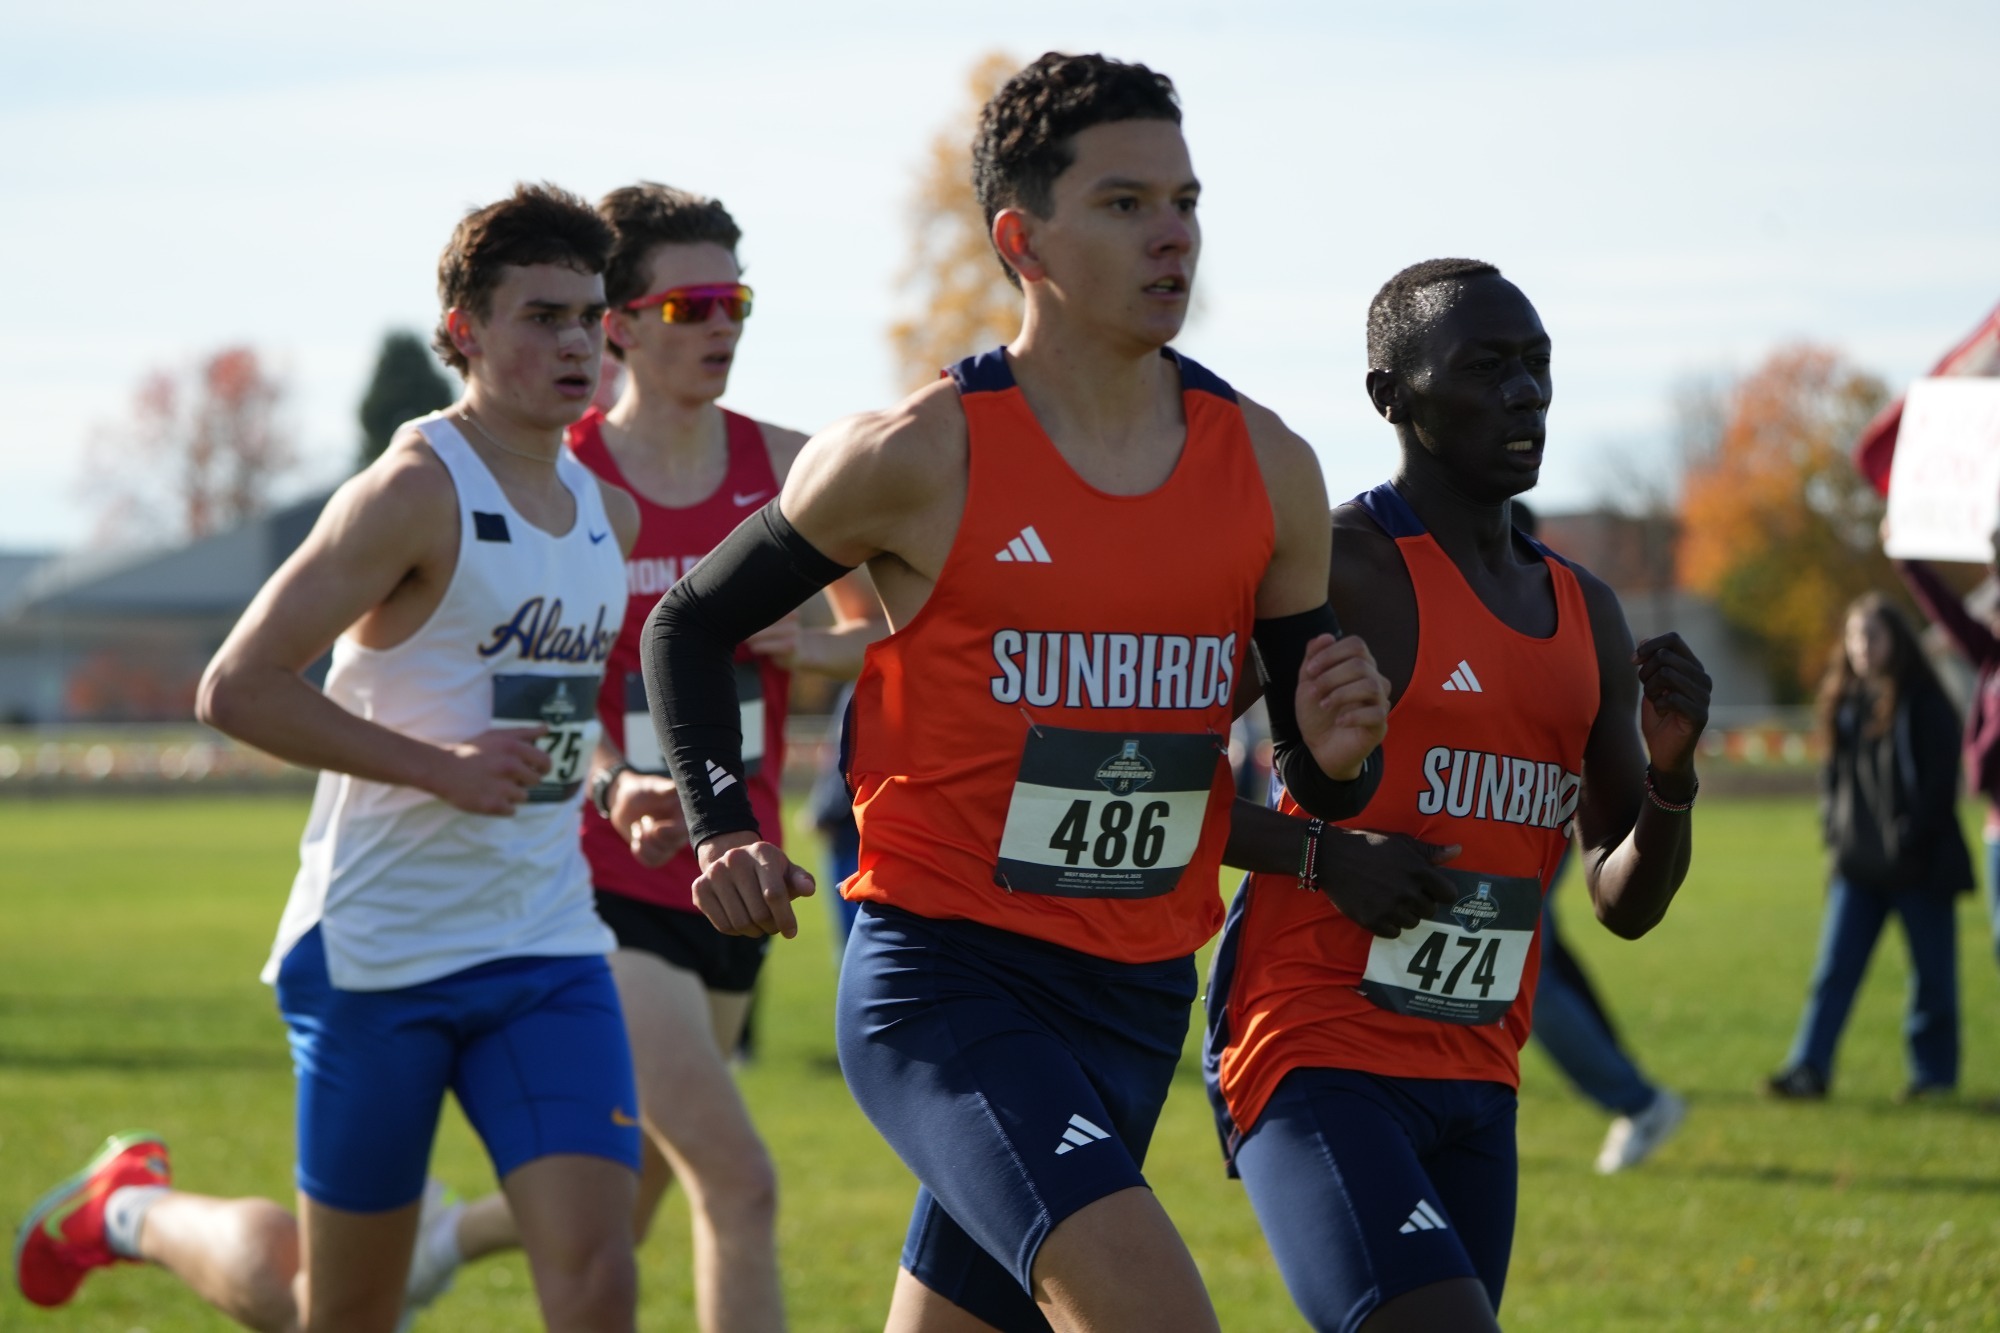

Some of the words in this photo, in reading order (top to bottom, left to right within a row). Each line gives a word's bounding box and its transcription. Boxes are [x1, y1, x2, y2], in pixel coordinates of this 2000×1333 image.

[989, 628, 1236, 709] SUNBIRDS
[533, 732, 583, 779] 75
[1097, 770, 1154, 779] CHAMPIONSHIPS
[1048, 799, 1170, 868] 486
[1452, 906, 1498, 919] CHAMPIONSHIPS
[1406, 931, 1502, 998] 474
